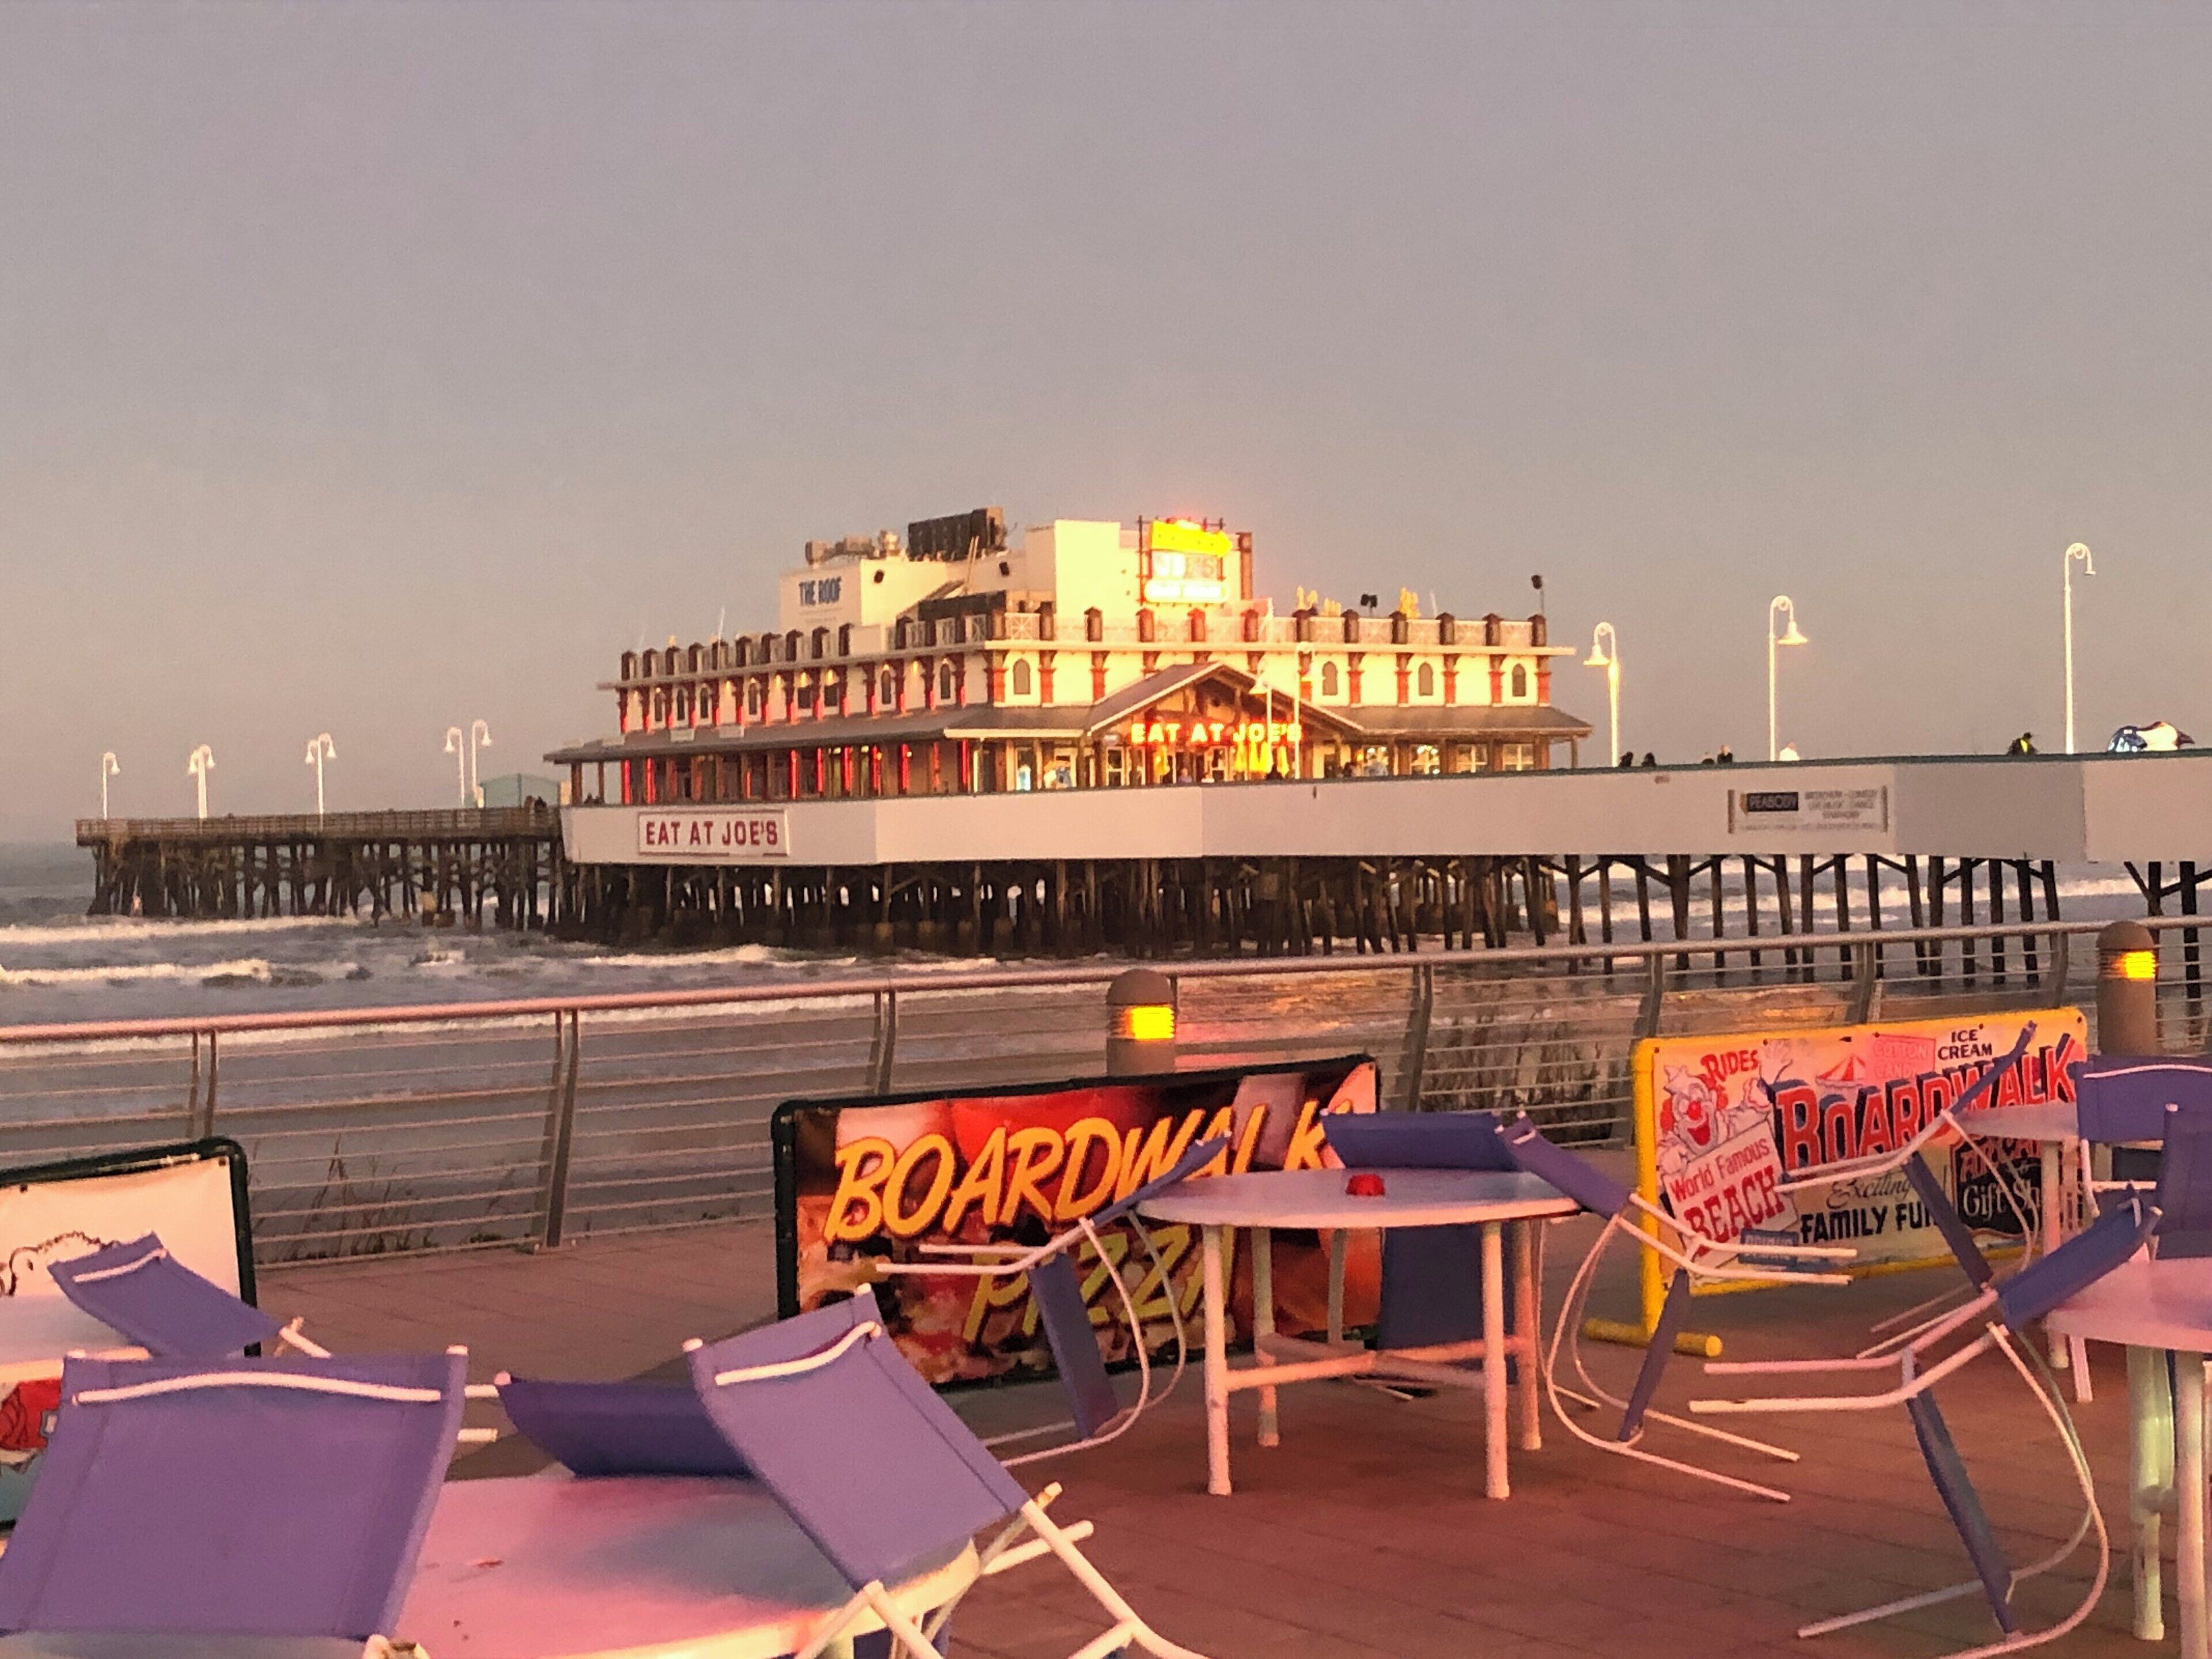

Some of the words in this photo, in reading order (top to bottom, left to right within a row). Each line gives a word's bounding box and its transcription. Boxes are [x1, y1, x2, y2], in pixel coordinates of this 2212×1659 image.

[1131, 722, 1181, 744] EAT
[1190, 722, 1225, 743] AT
[1232, 722, 1302, 743] JOE'S
[646, 820, 680, 845] EAT
[690, 820, 713, 846] AT
[722, 820, 778, 846] JOE'S
[1873, 1040, 1930, 1059] COTTON
[1937, 1043, 1993, 1060] CREAM
[1950, 1029, 1978, 1042] ICE
[1700, 1050, 1759, 1082] RIDES
[1768, 1035, 2076, 1175] BOARDWALK
[824, 1098, 1353, 1243] BOARDWALK
[1671, 1164, 1714, 1203] World
[1715, 1138, 1770, 1179] Famous
[1826, 1173, 1911, 1209] Exciting
[1963, 1182, 2007, 1222] Gift
[1684, 1164, 1785, 1257] BEACH
[1801, 1205, 1888, 1244] FAMILY
